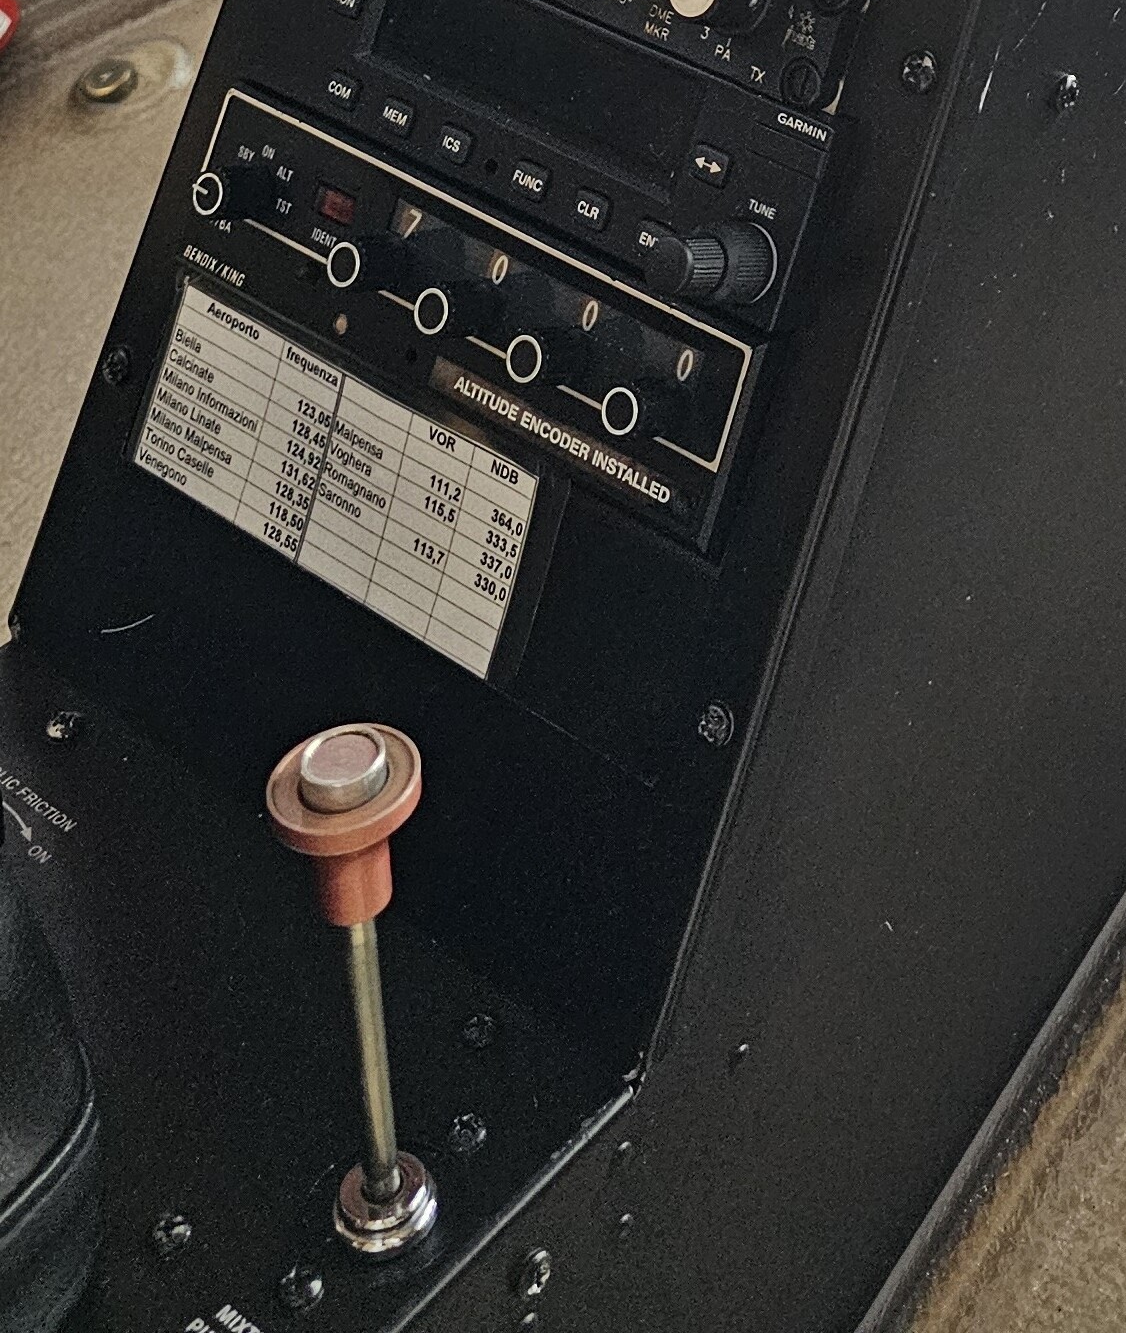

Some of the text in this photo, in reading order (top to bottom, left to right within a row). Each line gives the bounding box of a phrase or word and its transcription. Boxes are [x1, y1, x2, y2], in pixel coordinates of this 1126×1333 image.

[649, 3, 675, 25] DME
[643, 21, 670, 42] MKR
[327, 80, 352, 101] COM
[382, 105, 409, 128] MEM
[777, 111, 829, 143] GARMIN
[441, 134, 462, 154] ICS
[511, 169, 544, 194] FUNC
[576, 199, 601, 221] CLR
[749, 198, 779, 221] TUNE
[310, 226, 337, 249] IDENT
[174, 327, 202, 354] Biella
[206, 301, 339, 389] Aeroporto frequenza
[168, 348, 215, 384] Calcinate
[156, 386, 222, 435] Milano Linate
[162, 366, 260, 433] Milano Informazioni
[150, 406, 233, 466] Milano Malpensa
[296, 398, 384, 461] 123,05 Malpensa
[428, 425, 457, 453] VOR
[453, 375, 671, 505] ALTITUDE ENCODER INSTALLED
[145, 426, 215, 479] Torino Caselle
[291, 419, 373, 478] 128,45 Voghera
[137, 446, 188, 487] Venegono
[286, 439, 387, 510] 124,92 Romagnano
[489, 459, 520, 485] NDB
[274, 479, 310, 511] 128,35
[280, 459, 362, 519] 131,62 Saronno
[429, 474, 462, 504] 111,2
[268, 500, 304, 532] 118,50
[423, 495, 457, 524] 115,5
[490, 508, 524, 537] 364,0
[262, 521, 299, 554] 128,55
[412, 537, 446, 567] 113,7
[485, 529, 518, 559] 333,5
[479, 551, 513, 581] 337,0
[473, 573, 507, 603] 330,0
[15, 786, 78, 833] FRICTION
[27, 844, 53, 864] ON
